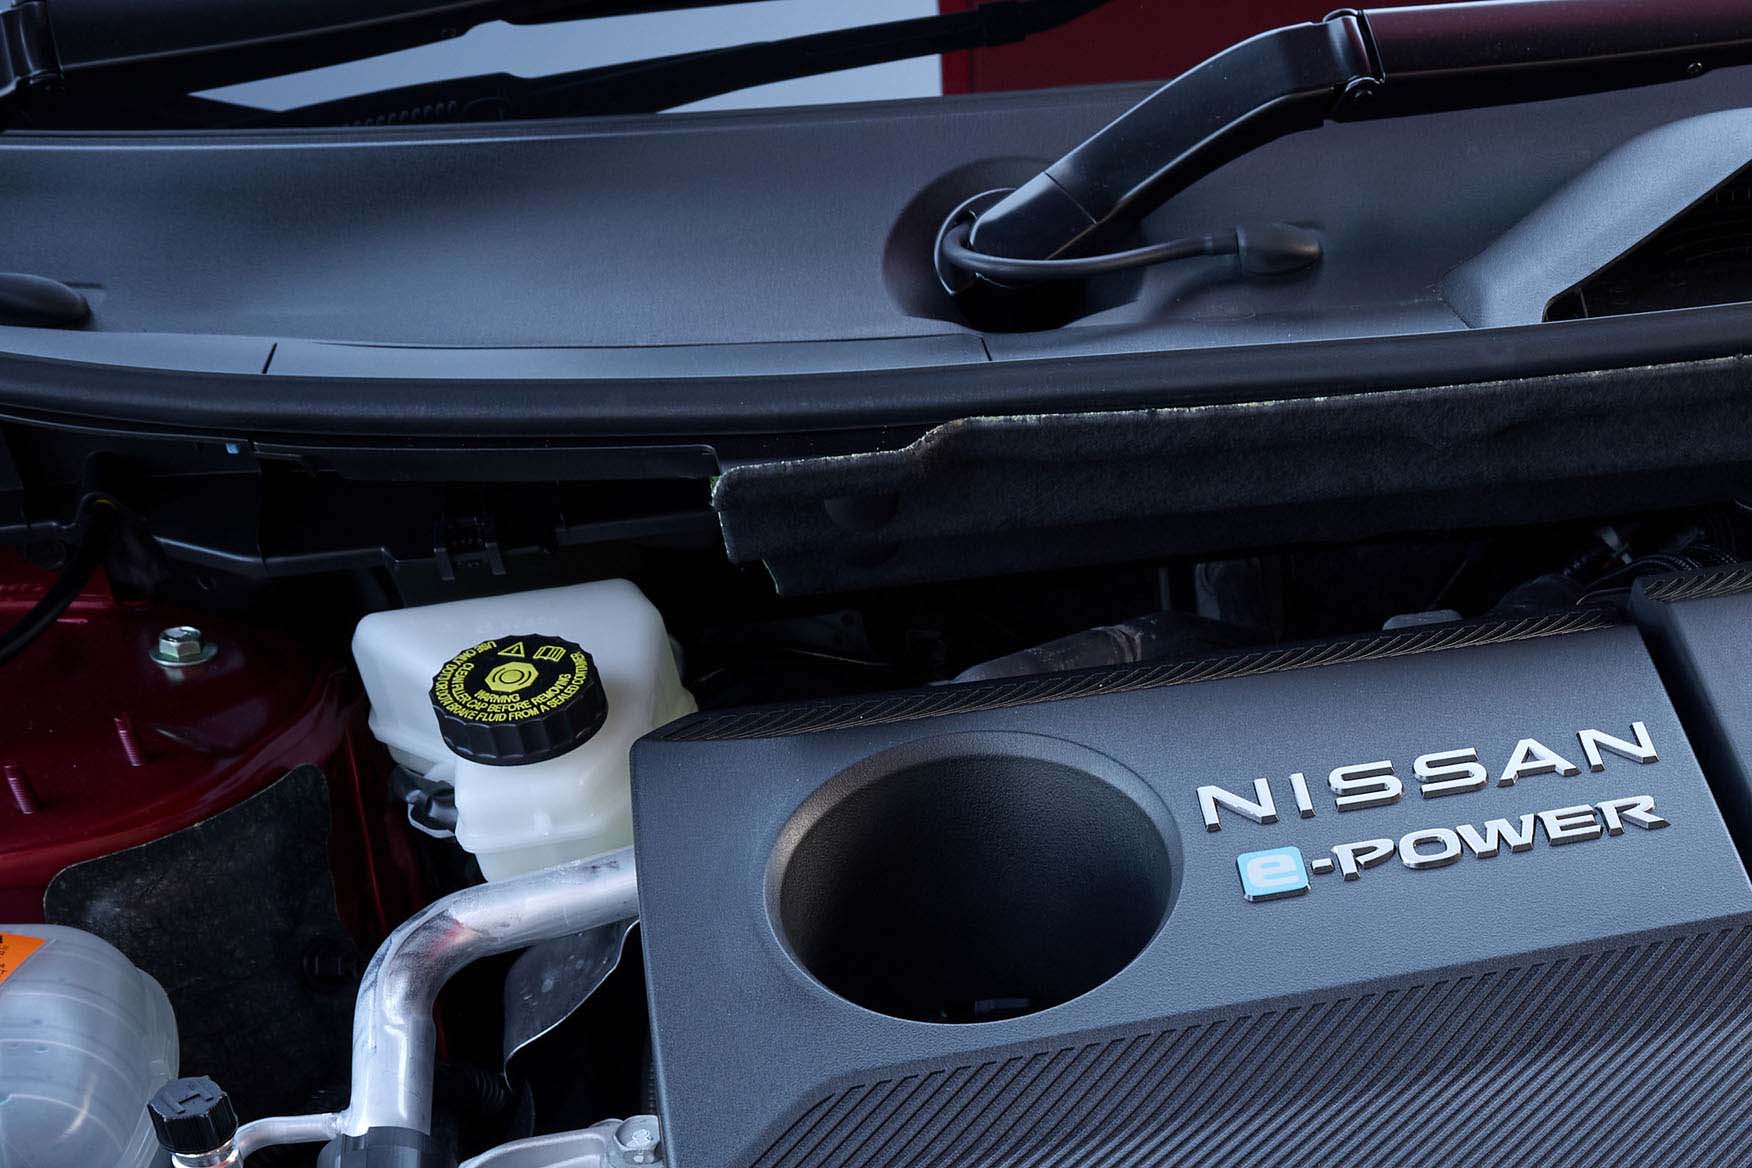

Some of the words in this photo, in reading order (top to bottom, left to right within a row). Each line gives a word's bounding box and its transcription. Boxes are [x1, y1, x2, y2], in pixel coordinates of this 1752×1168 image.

[469, 699, 489, 711] CAP
[488, 700, 532, 713] BEFORE
[531, 673, 572, 705] REMOVING
[474, 689, 521, 703] WARNING
[446, 703, 478, 719] BRAKE
[476, 711, 507, 722] FLUID
[508, 706, 540, 721] FROM
[1195, 720, 1660, 832] NISSAN
